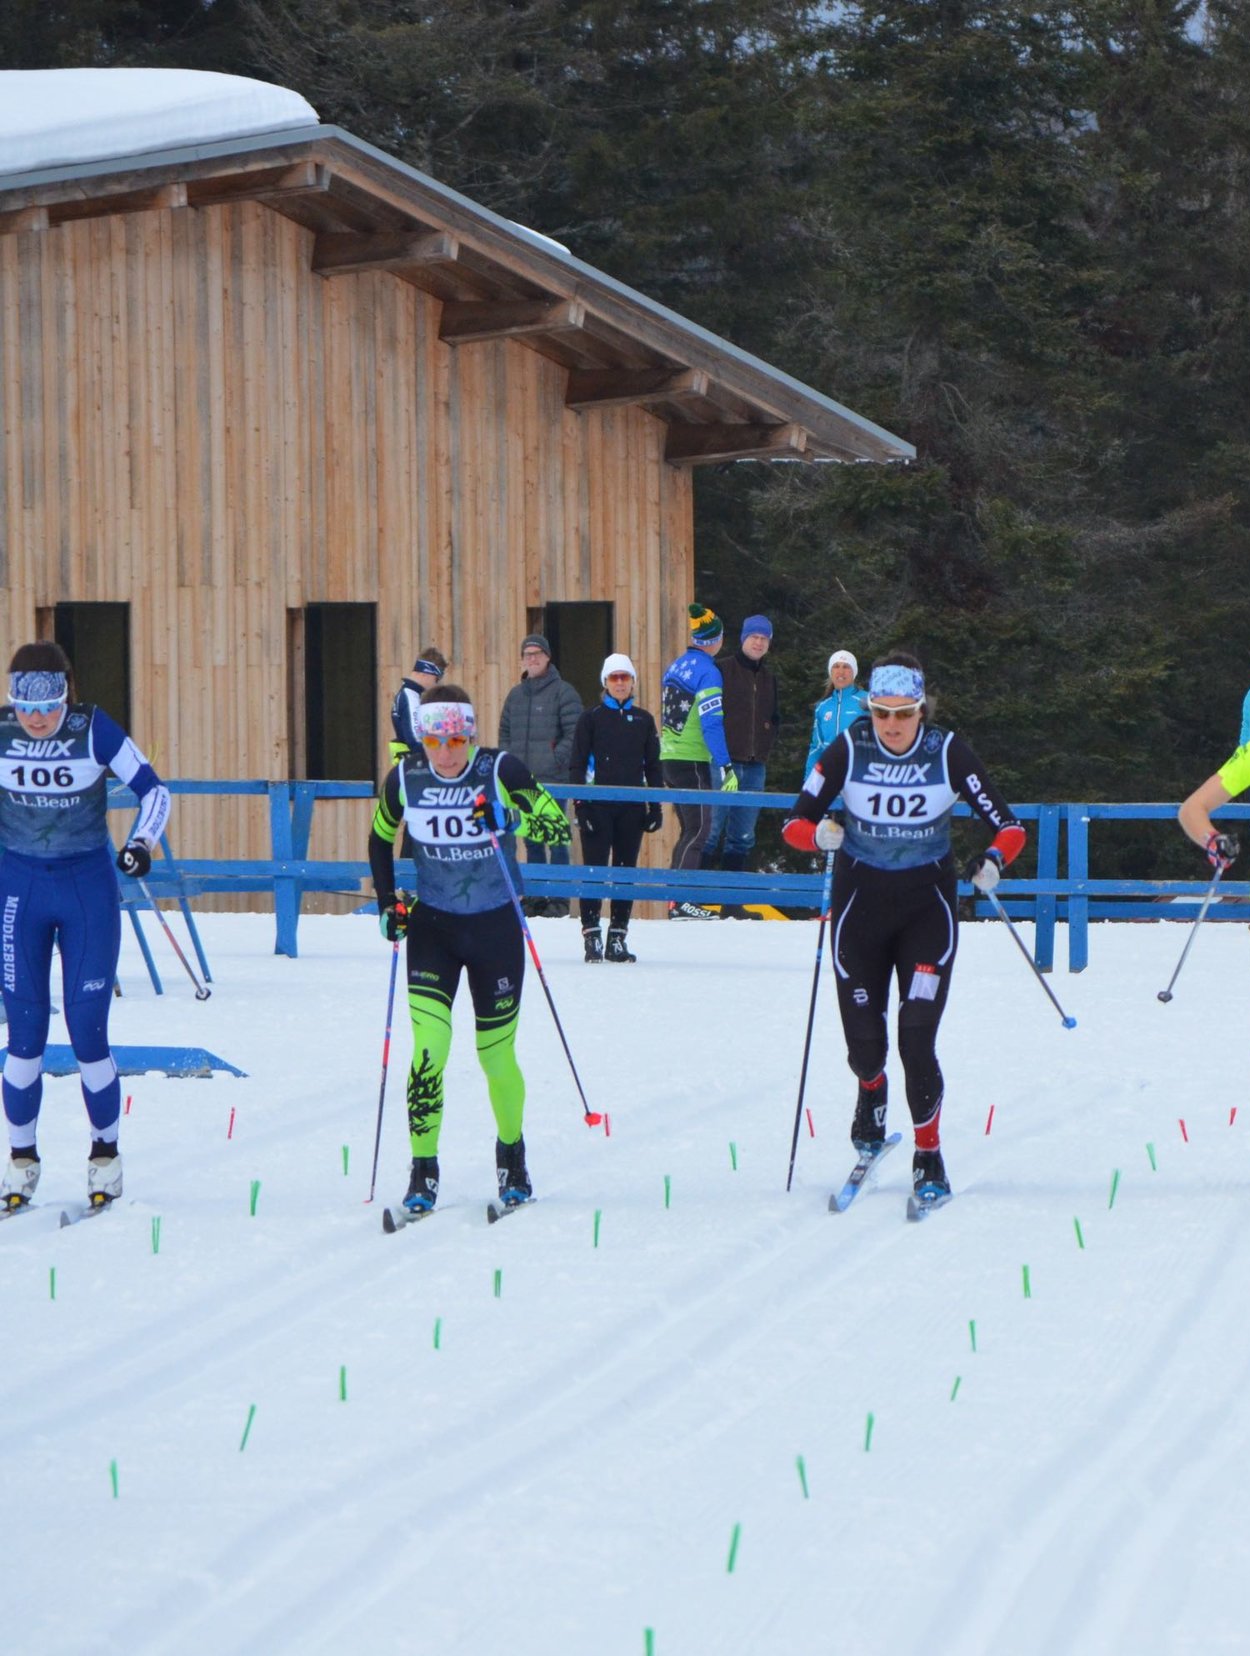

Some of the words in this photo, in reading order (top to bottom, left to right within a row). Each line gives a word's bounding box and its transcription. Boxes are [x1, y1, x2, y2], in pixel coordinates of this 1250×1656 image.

[5, 738, 76, 758] SWIX
[11, 765, 75, 787] 106
[863, 762, 931, 784] SWIX
[8, 791, 81, 809] L.L.Bean
[418, 784, 486, 807] SWIX
[867, 792, 927, 818] 102
[426, 815, 484, 838] 103
[857, 821, 935, 840] L.L.Bean
[423, 846, 495, 862] L.L.Bean
[2, 895, 19, 992] MIDDLEBURY
